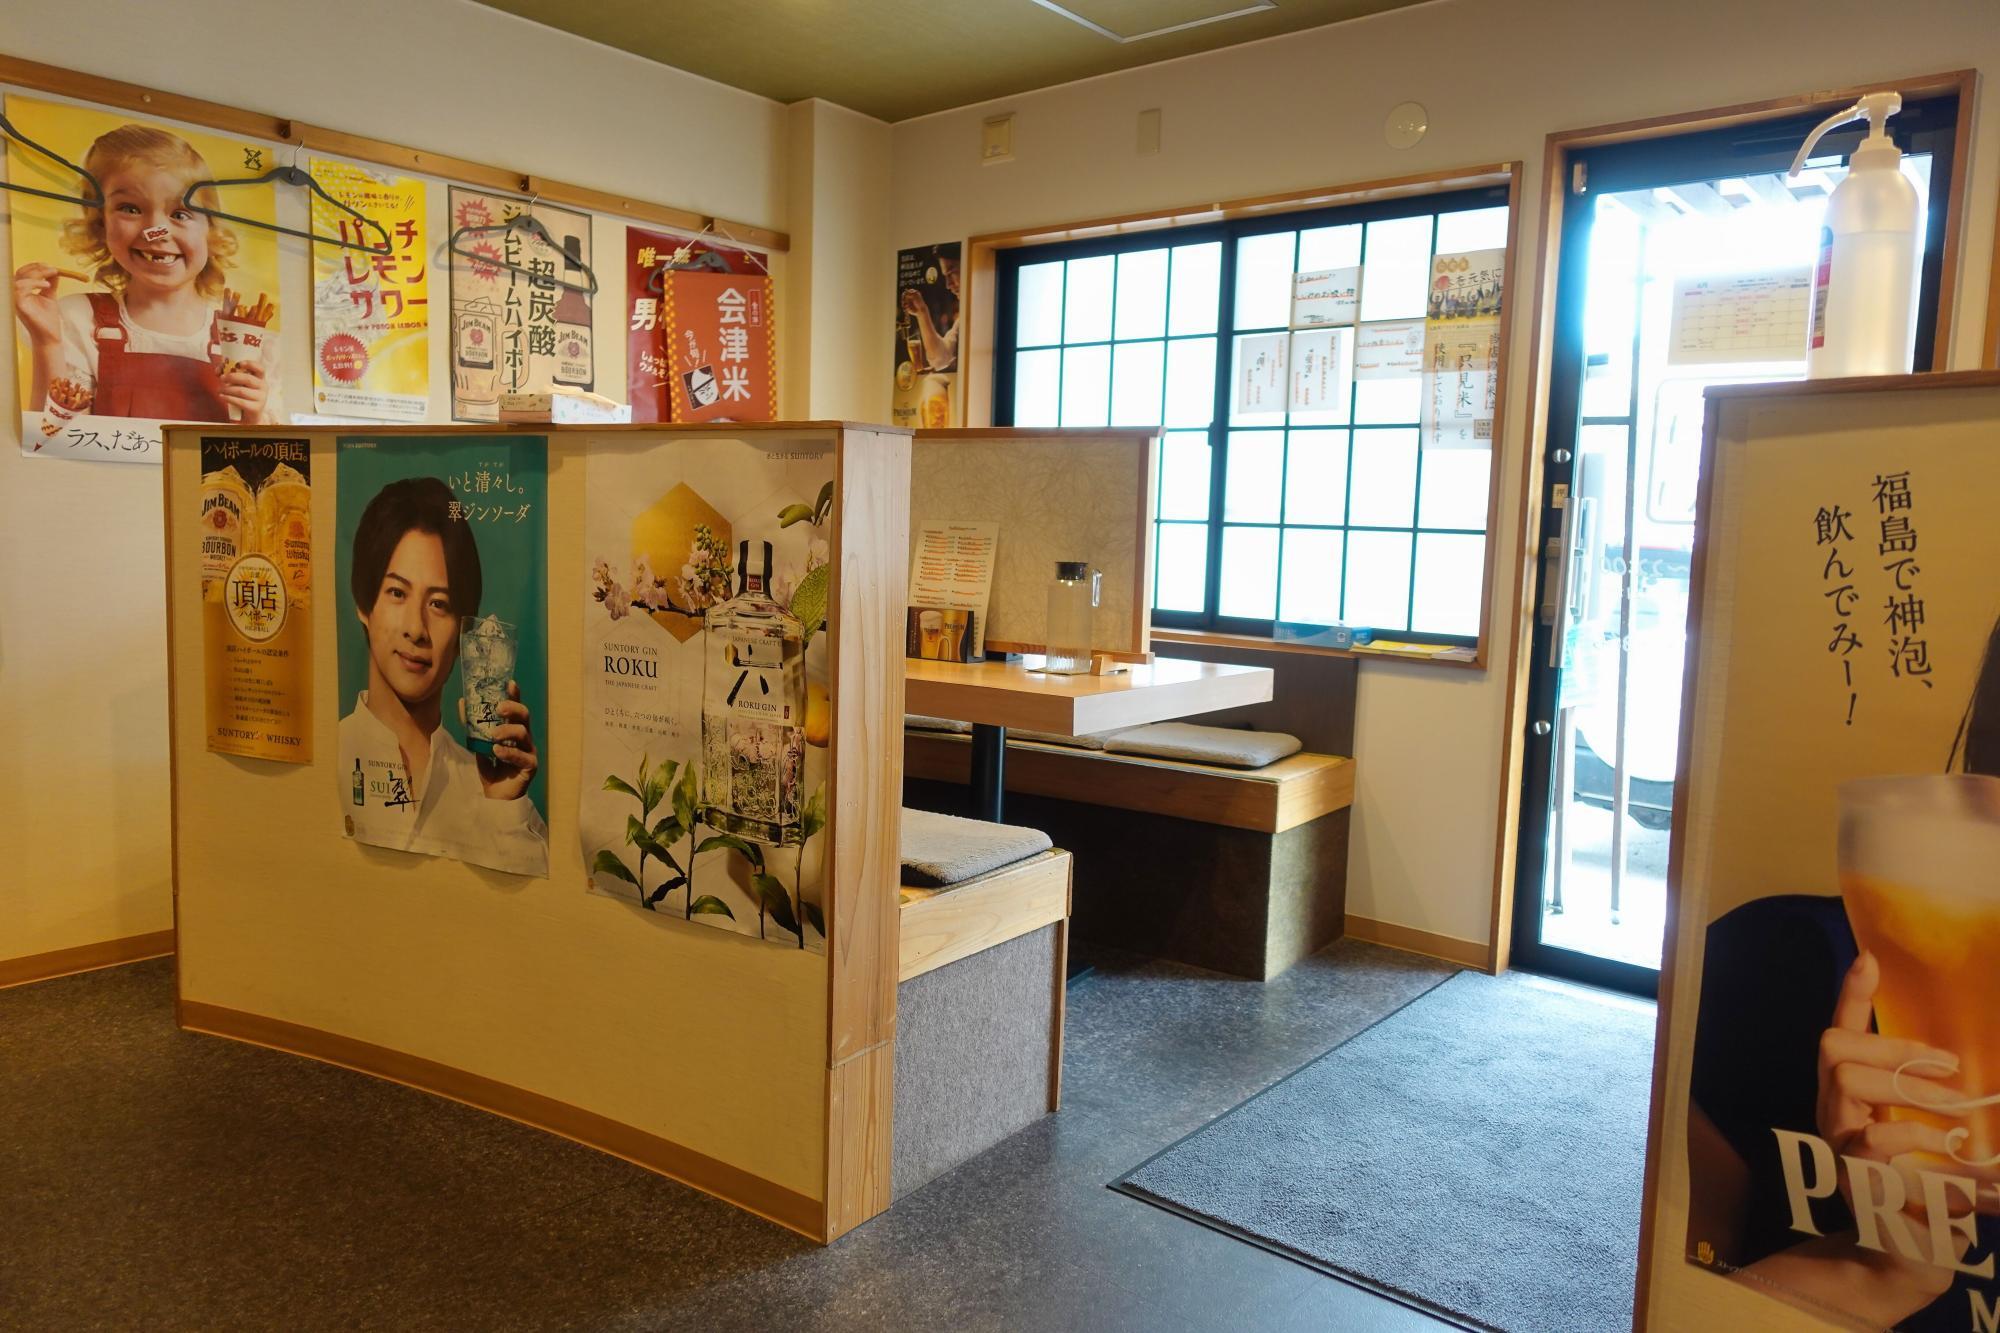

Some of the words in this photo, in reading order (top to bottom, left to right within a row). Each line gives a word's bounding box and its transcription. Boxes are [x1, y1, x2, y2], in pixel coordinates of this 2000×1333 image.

[344, 254, 425, 286] レモン
[350, 290, 428, 320] サワー
[527, 259, 556, 358] 超炭酸
[631, 298, 665, 330] 男
[716, 287, 751, 401] 会津米
[205, 441, 308, 462] ハイボールの頂店。
[448, 471, 524, 494] いと清々し。
[202, 497, 217, 517] JIM
[217, 493, 240, 520] BEAM
[447, 501, 531, 523] 翠ジンソーダ
[1871, 471, 1933, 689] 福島で神泡、
[232, 580, 278, 610] 頂店
[239, 609, 275, 622] ハイボール
[604, 643, 639, 654] SUNTORY
[642, 647, 657, 656] GIN
[604, 656, 658, 678] ROKU
[738, 700, 760, 710] ROKU
[762, 704, 777, 712] GIN
[217, 727, 256, 740] SUNTORY
[267, 735, 301, 746] WHISKY
[368, 759, 397, 769] SUNTORY
[370, 780, 390, 794] SUI
[1771, 1127, 2000, 1280] PRE
